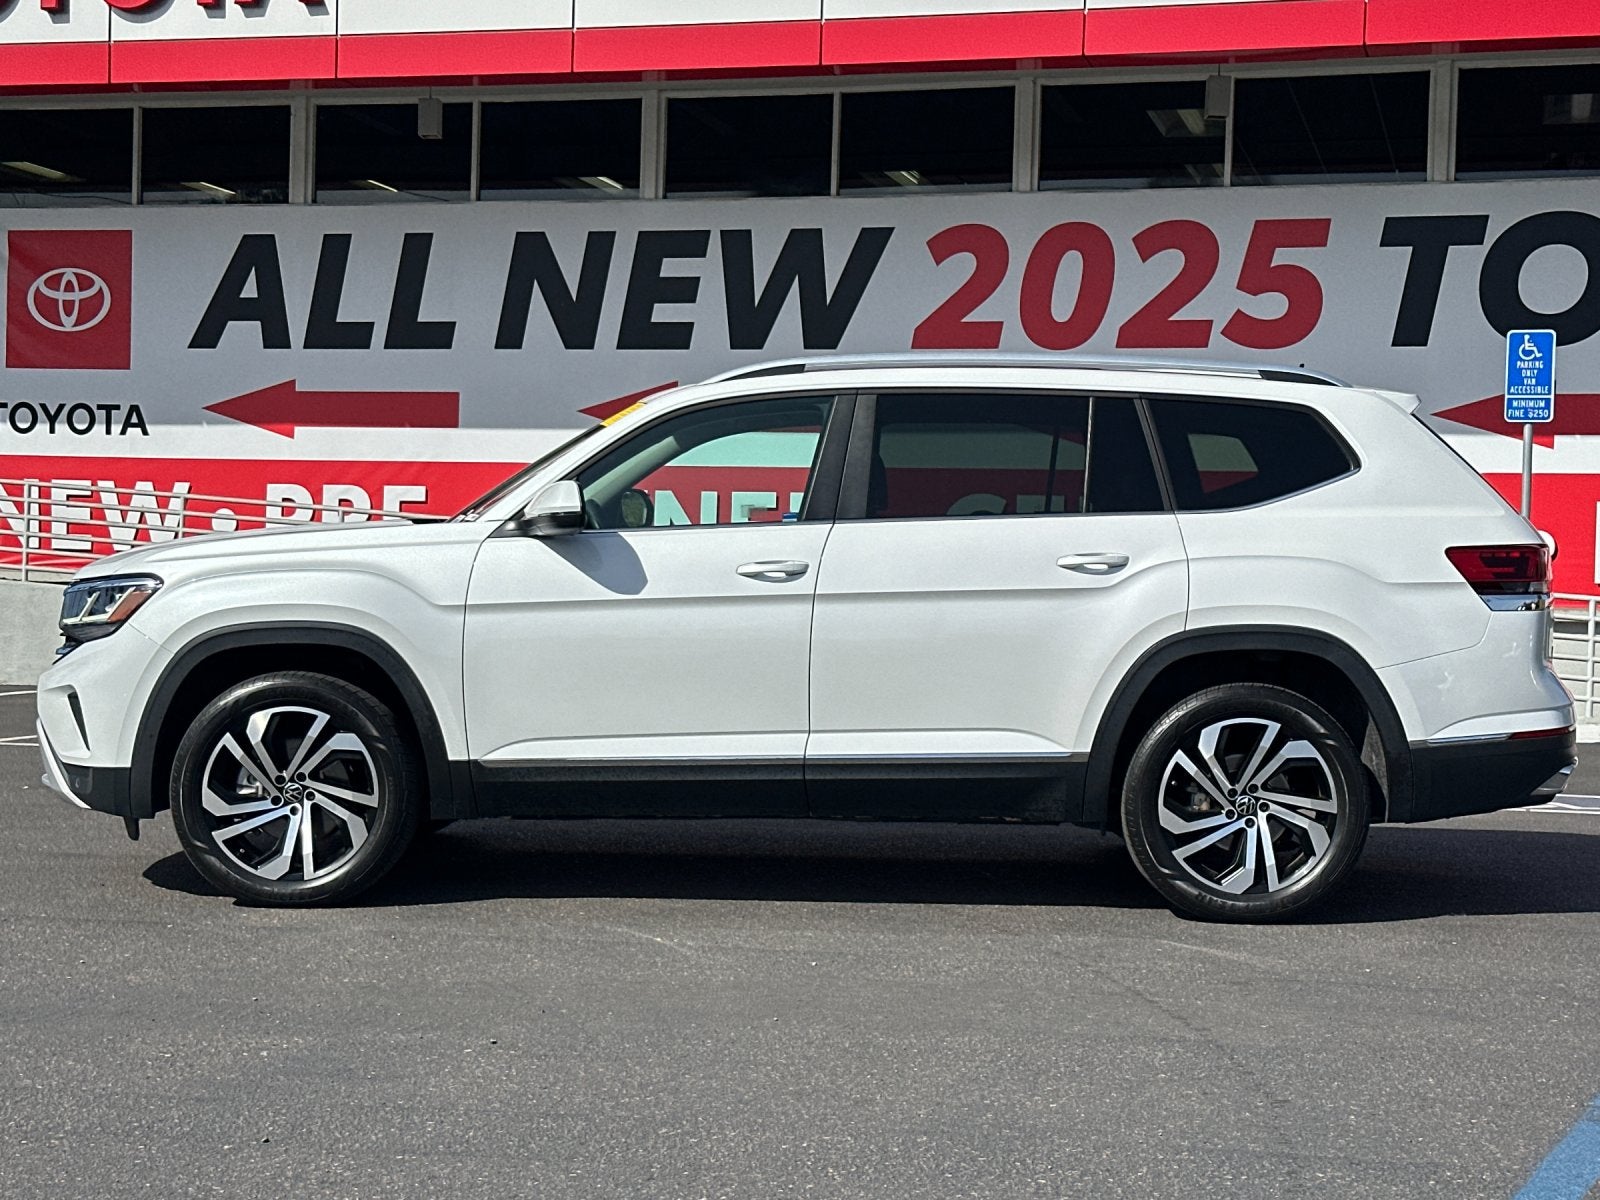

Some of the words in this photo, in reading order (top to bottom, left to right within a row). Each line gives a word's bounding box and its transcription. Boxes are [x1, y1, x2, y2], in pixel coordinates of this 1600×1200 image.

[188, 232, 457, 349] ALL
[495, 227, 895, 350] NEW
[911, 218, 1331, 350] 2025
[1516, 360, 1543, 369] PARKING
[1521, 369, 1538, 378] ONLY
[1523, 378, 1536, 386] VAN
[1509, 385, 1549, 394] ACCESSIBLE
[1512, 399, 1546, 408] MINIMUM
[1507, 409, 1525, 418] FINE
[1527, 408, 1549, 418] $250
